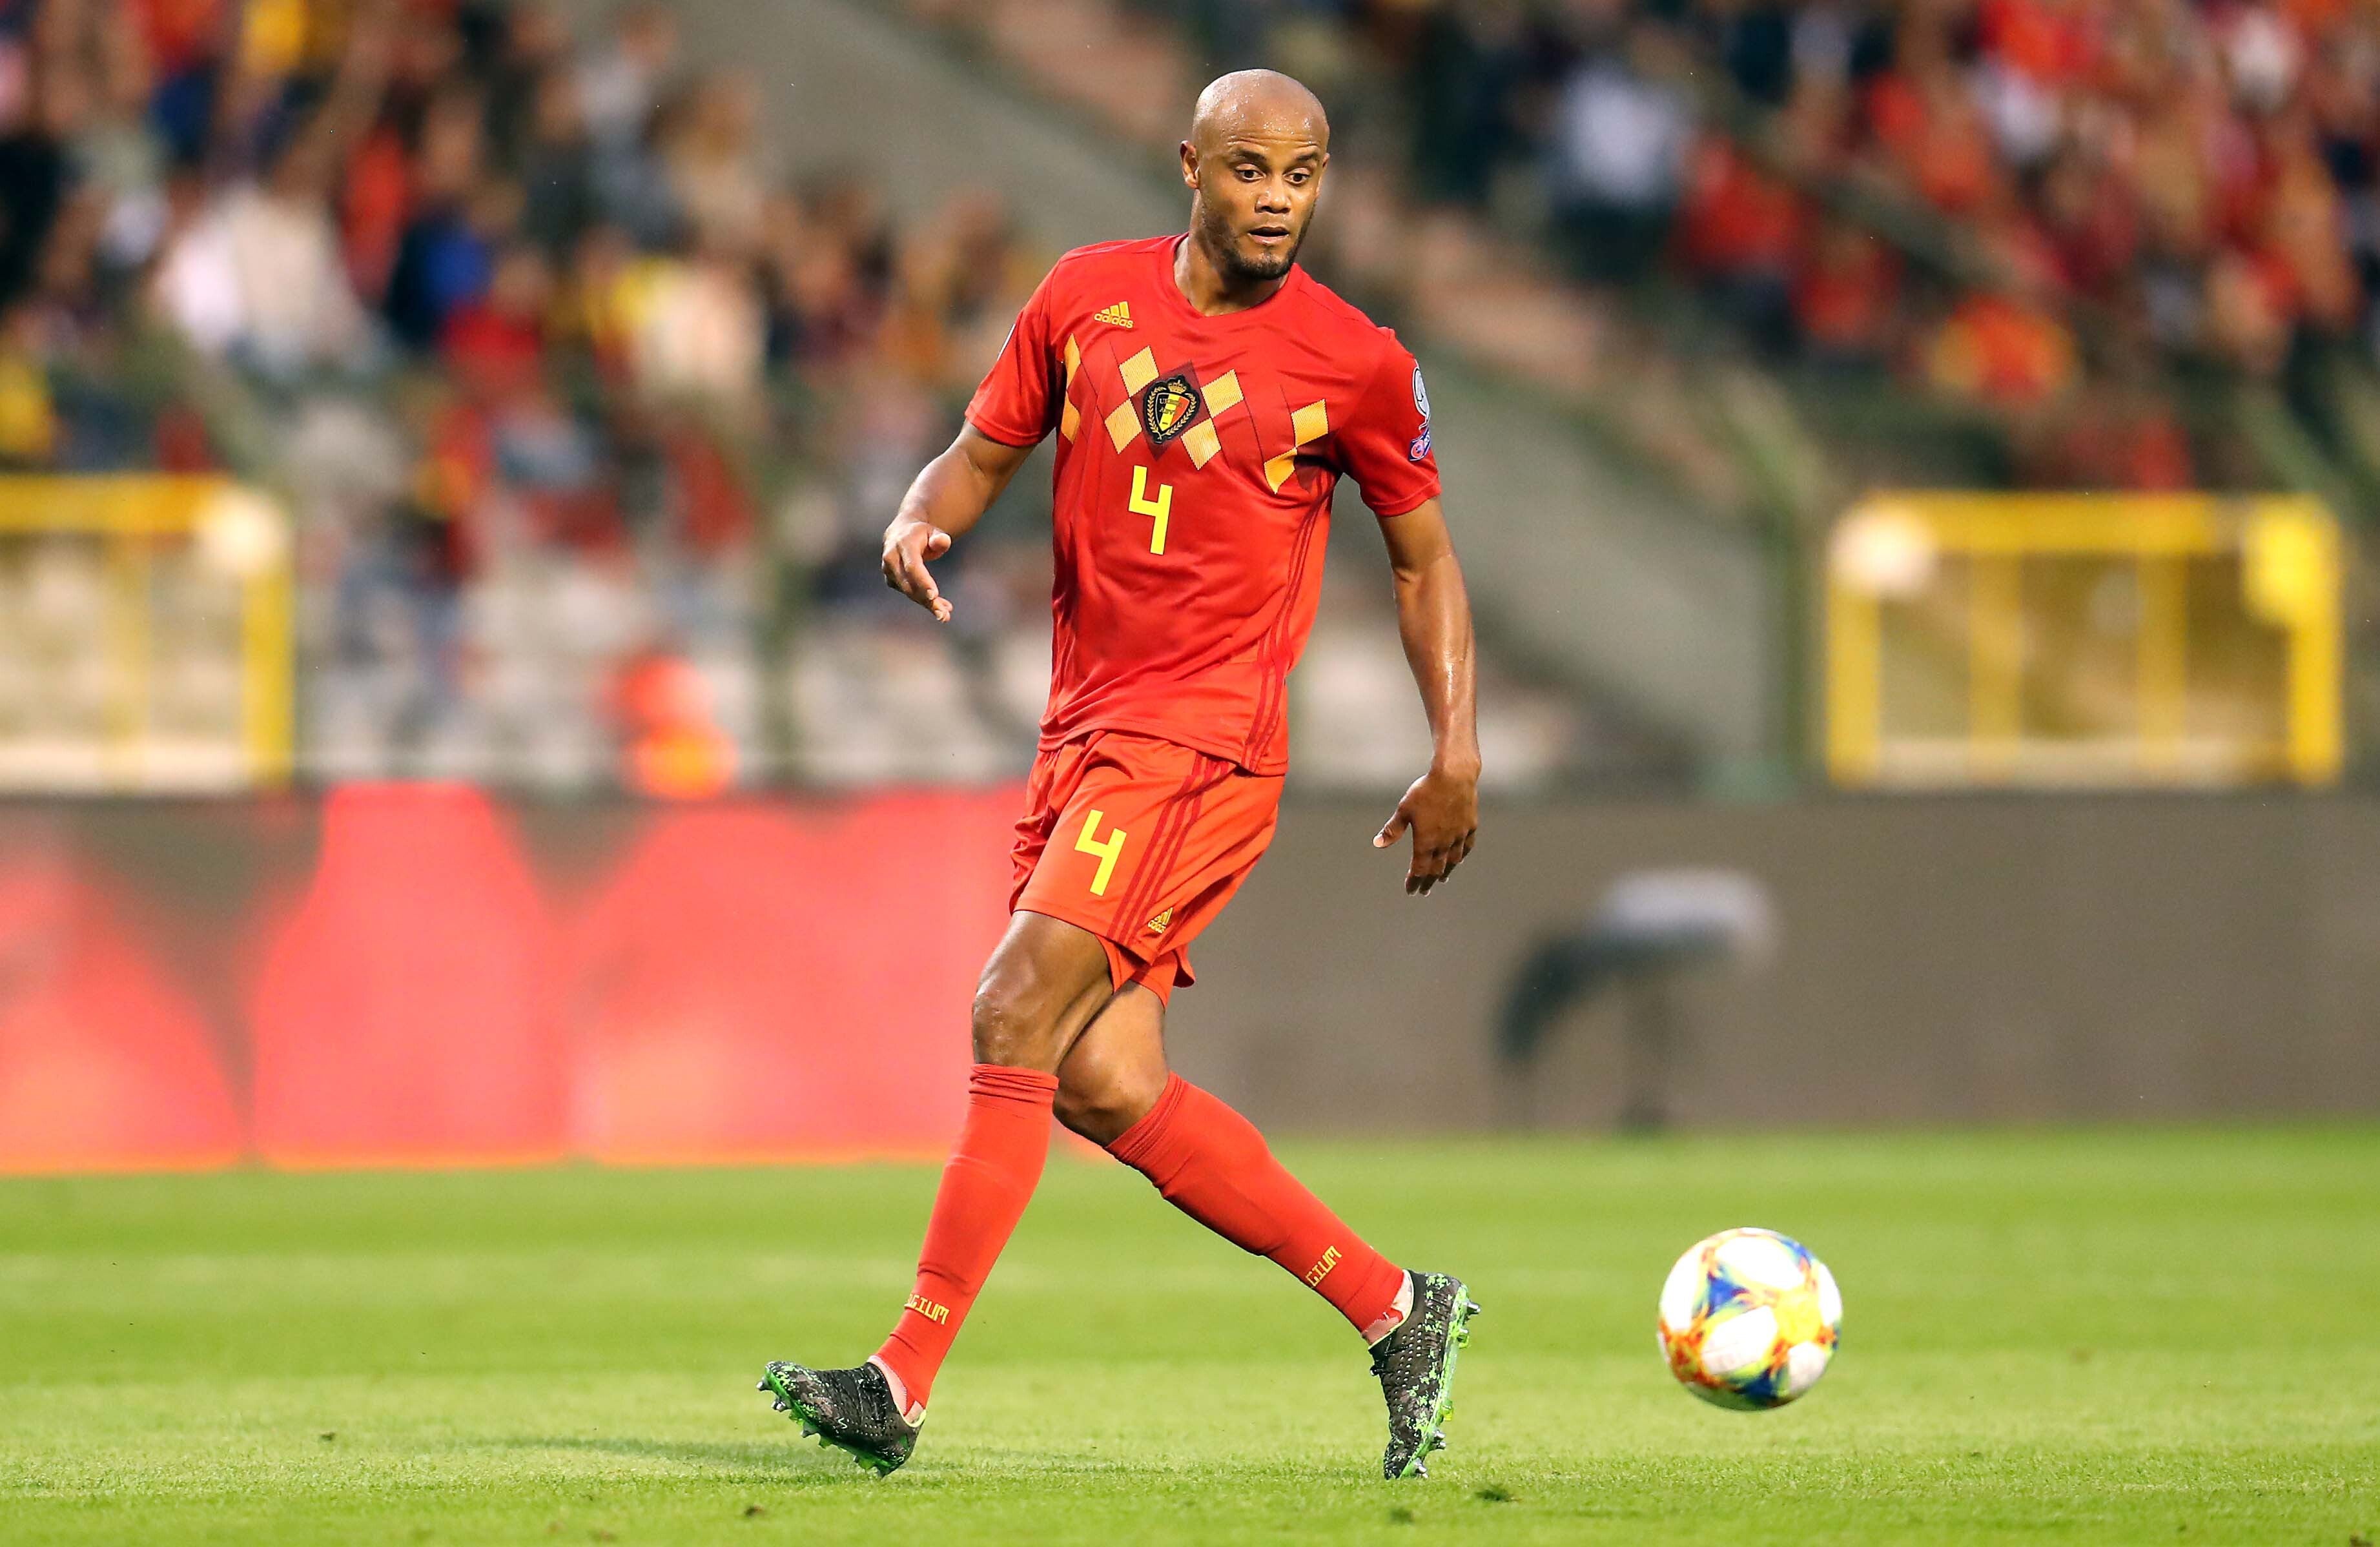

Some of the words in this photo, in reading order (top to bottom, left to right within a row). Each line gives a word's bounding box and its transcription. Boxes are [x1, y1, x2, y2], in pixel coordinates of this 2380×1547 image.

[1094, 312, 1134, 329] adidas
[1128, 465, 1173, 555] 4
[1074, 809, 1127, 897] 4
